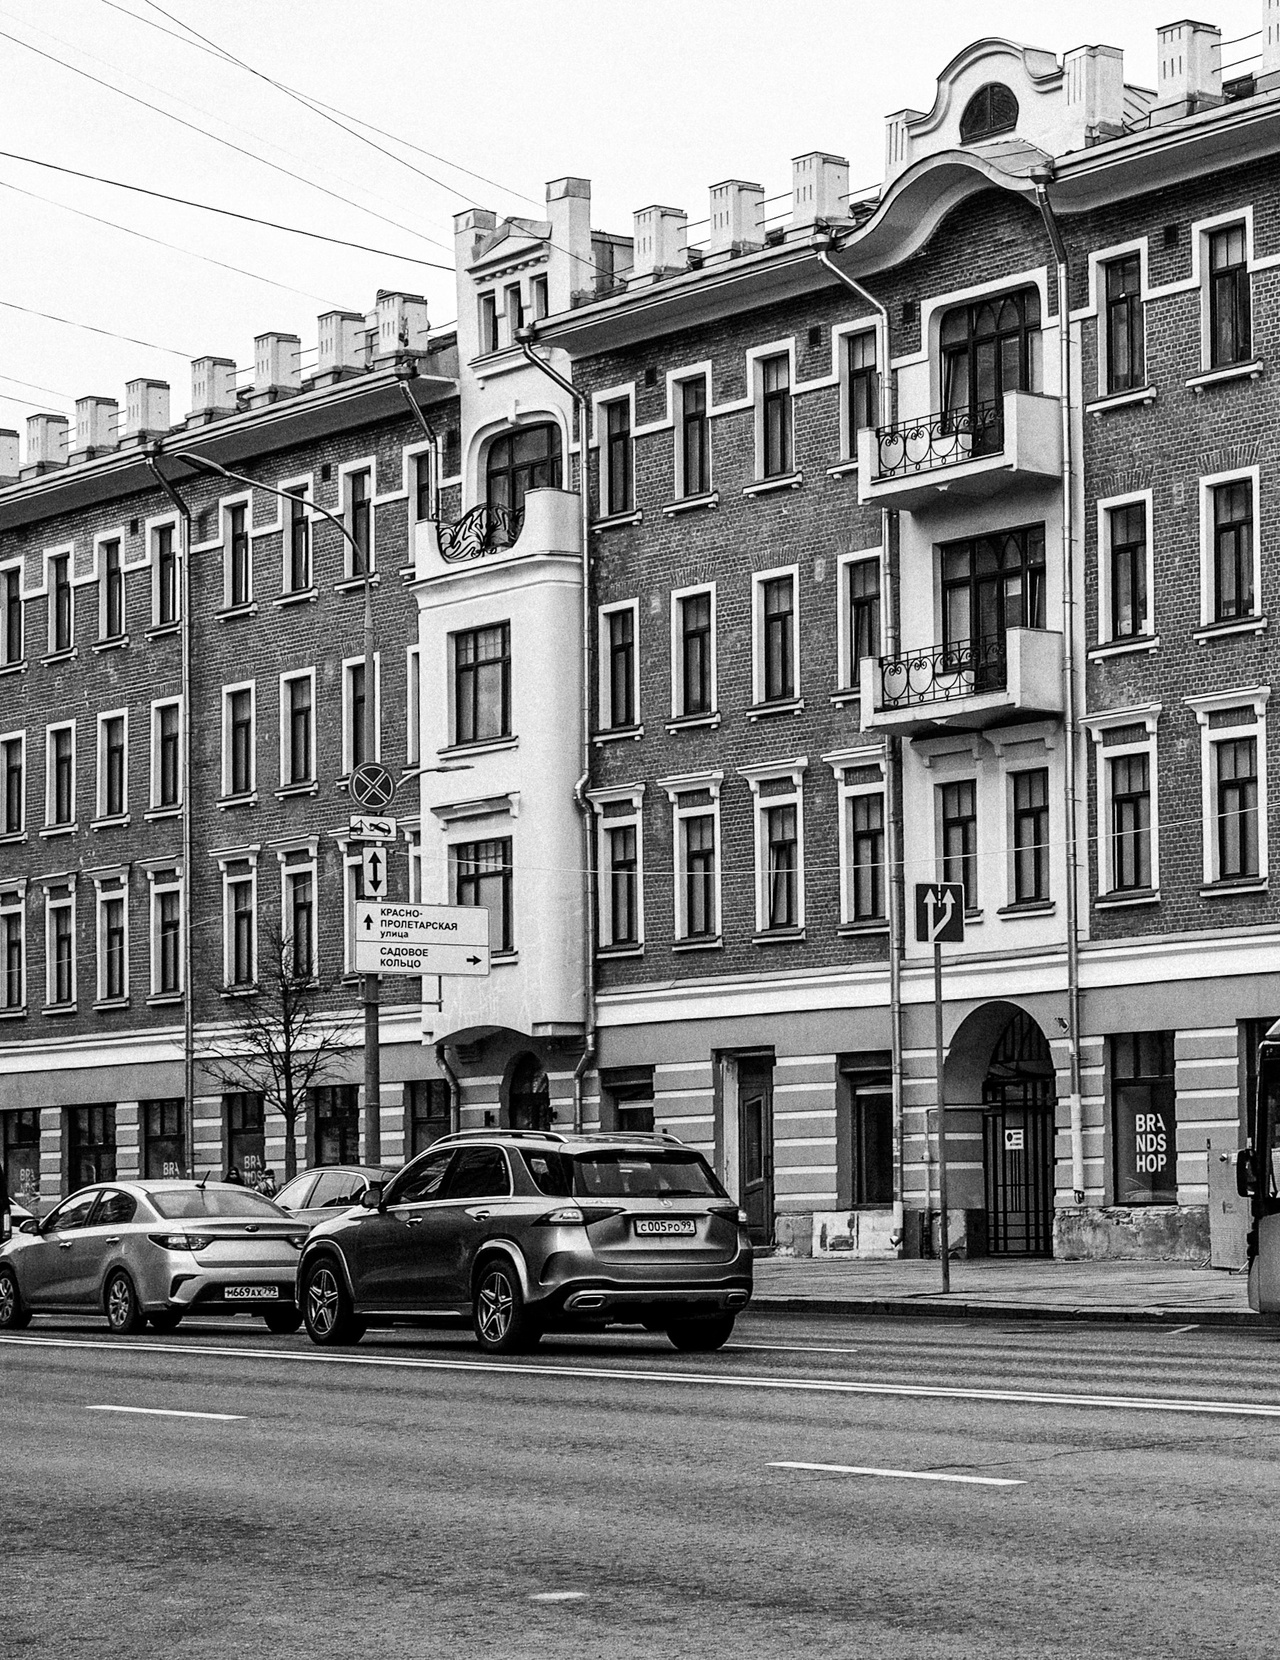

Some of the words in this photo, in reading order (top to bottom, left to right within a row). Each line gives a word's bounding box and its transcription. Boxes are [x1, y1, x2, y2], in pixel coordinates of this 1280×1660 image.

[380, 908, 423, 918] КРАСНО-
[380, 919, 458, 931] ПРОЛЕТАРСКАЯ
[380, 930, 409, 939] улица
[380, 947, 429, 957] САДОВОЕ
[380, 958, 421, 969] КОЛЬЦО
[1135, 1113, 1166, 1132] BRA
[1135, 1134, 1167, 1152] NDS
[1136, 1154, 1167, 1173] HOP
